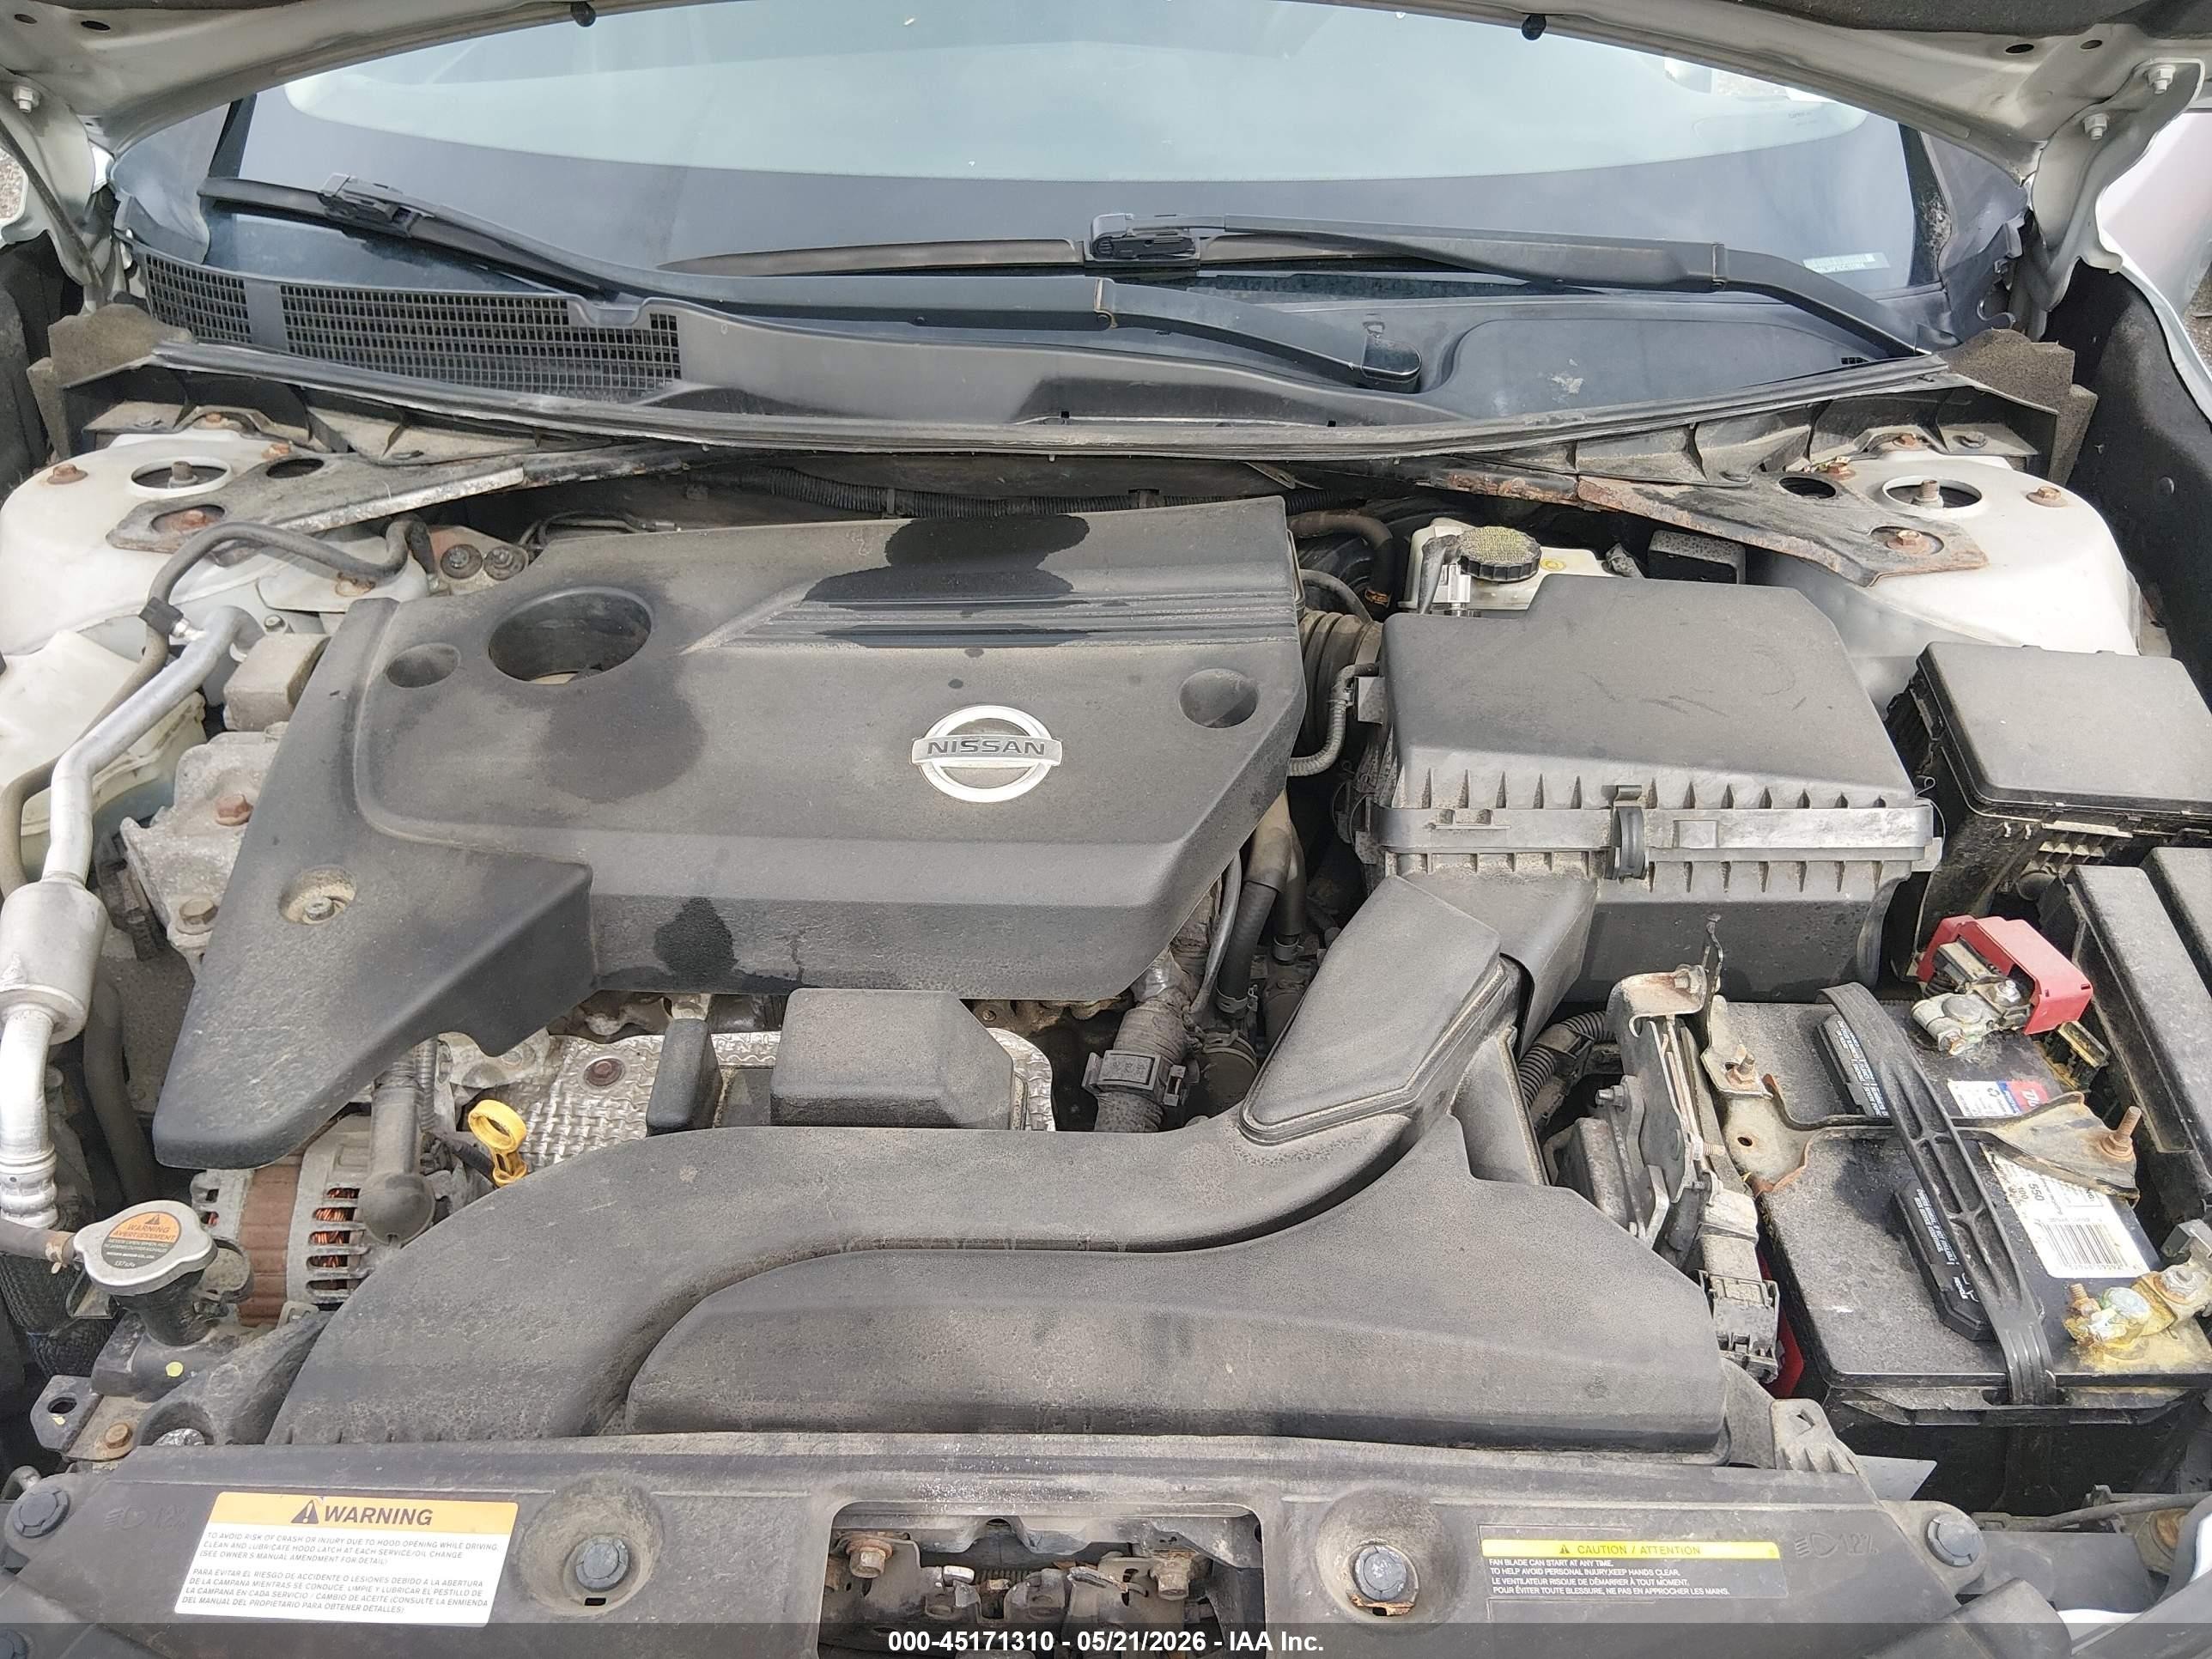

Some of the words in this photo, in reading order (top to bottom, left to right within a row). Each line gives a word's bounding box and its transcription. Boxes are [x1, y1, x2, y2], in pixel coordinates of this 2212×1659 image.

[927, 739, 1045, 756] NISSAN
[2018, 1187, 2028, 1200] 100
[2028, 1182, 2045, 1201] 550
[127, 1224, 171, 1234] WARNING
[113, 1231, 176, 1241] AVERTISSEMENT
[323, 1504, 434, 1527] WARNING
[378, 1539, 400, 1547] HOOD
[1577, 1545, 1627, 1555] CAUTION
[1640, 1545, 1701, 1556] ATTENTION
[289, 1554, 339, 1563] AMENDMENT
[253, 1571, 283, 1579] RIESGO
[296, 1573, 341, 1582] ACCIDENTE
[350, 1575, 389, 1583] LESIONES
[391, 1577, 422, 1585] DEBIDO
[1628, 1568, 1654, 1577] HANDS
[1655, 1568, 1680, 1577] CLEAR.
[213, 1578, 250, 1587] CAMPANA
[252, 1580, 292, 1589] MIENTRAS
[381, 1586, 421, 1595] LUBRICAR
[434, 1588, 470, 1596] PESTILLO
[1589, 1577, 1629, 1586] DÉMARRER
[1630, 1577, 1636, 1586] À
[1515, 1585, 1540, 1595] ÉVITER
[1565, 1587, 1605, 1595] BLESSURE,
[315, 1592, 347, 1601] CAMBIO
[361, 1595, 391, 1603] ACEITE
[249, 1599, 301, 1608] PROPIETARIO
[324, 1602, 362, 1611] OBTENER
